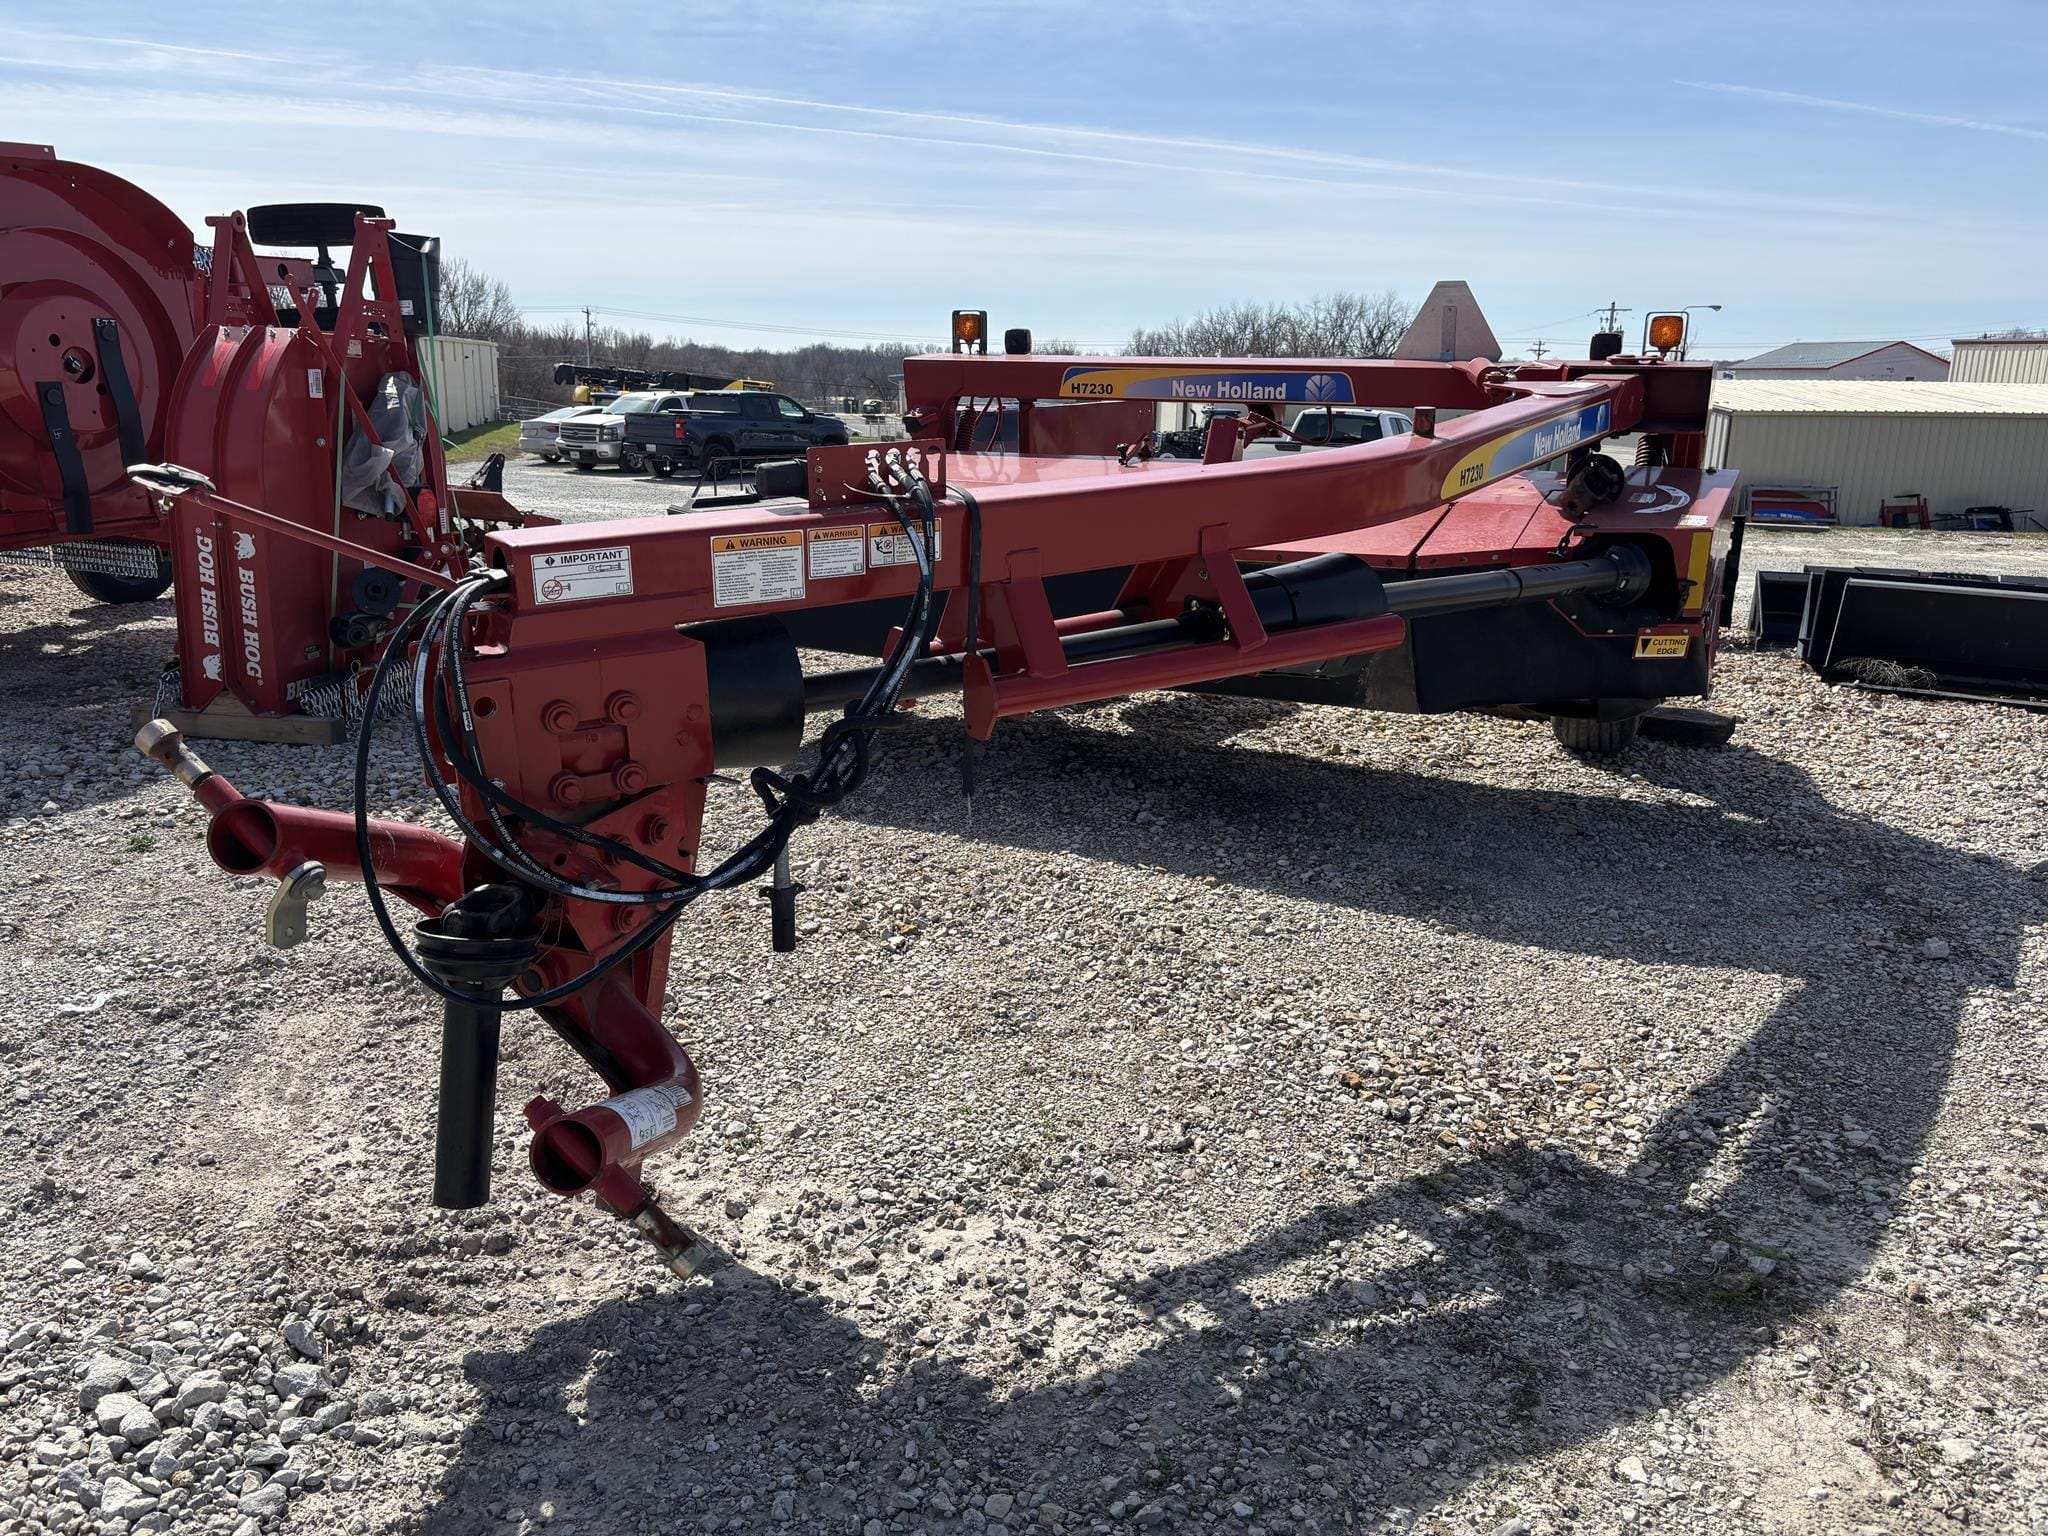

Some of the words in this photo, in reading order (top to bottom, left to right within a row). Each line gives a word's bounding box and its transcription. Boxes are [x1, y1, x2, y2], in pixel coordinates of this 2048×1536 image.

[1071, 382, 1113, 395] H7230
[1171, 380, 1211, 397] New
[1217, 381, 1287, 400] Holland
[1460, 464, 1484, 487] H7230
[1533, 433, 1553, 459] New
[1554, 416, 1582, 451] Holland
[739, 536, 787, 548] WARNING
[822, 530, 859, 539] WARNING
[196, 534, 216, 585] HOG
[560, 550, 623, 564] IMPORTANT
[238, 566, 258, 628] BUSH
[200, 587, 220, 648] BUSH
[243, 628, 262, 678] HOG
[490, 807, 499, 820] USA
[500, 825, 512, 842] MADE
